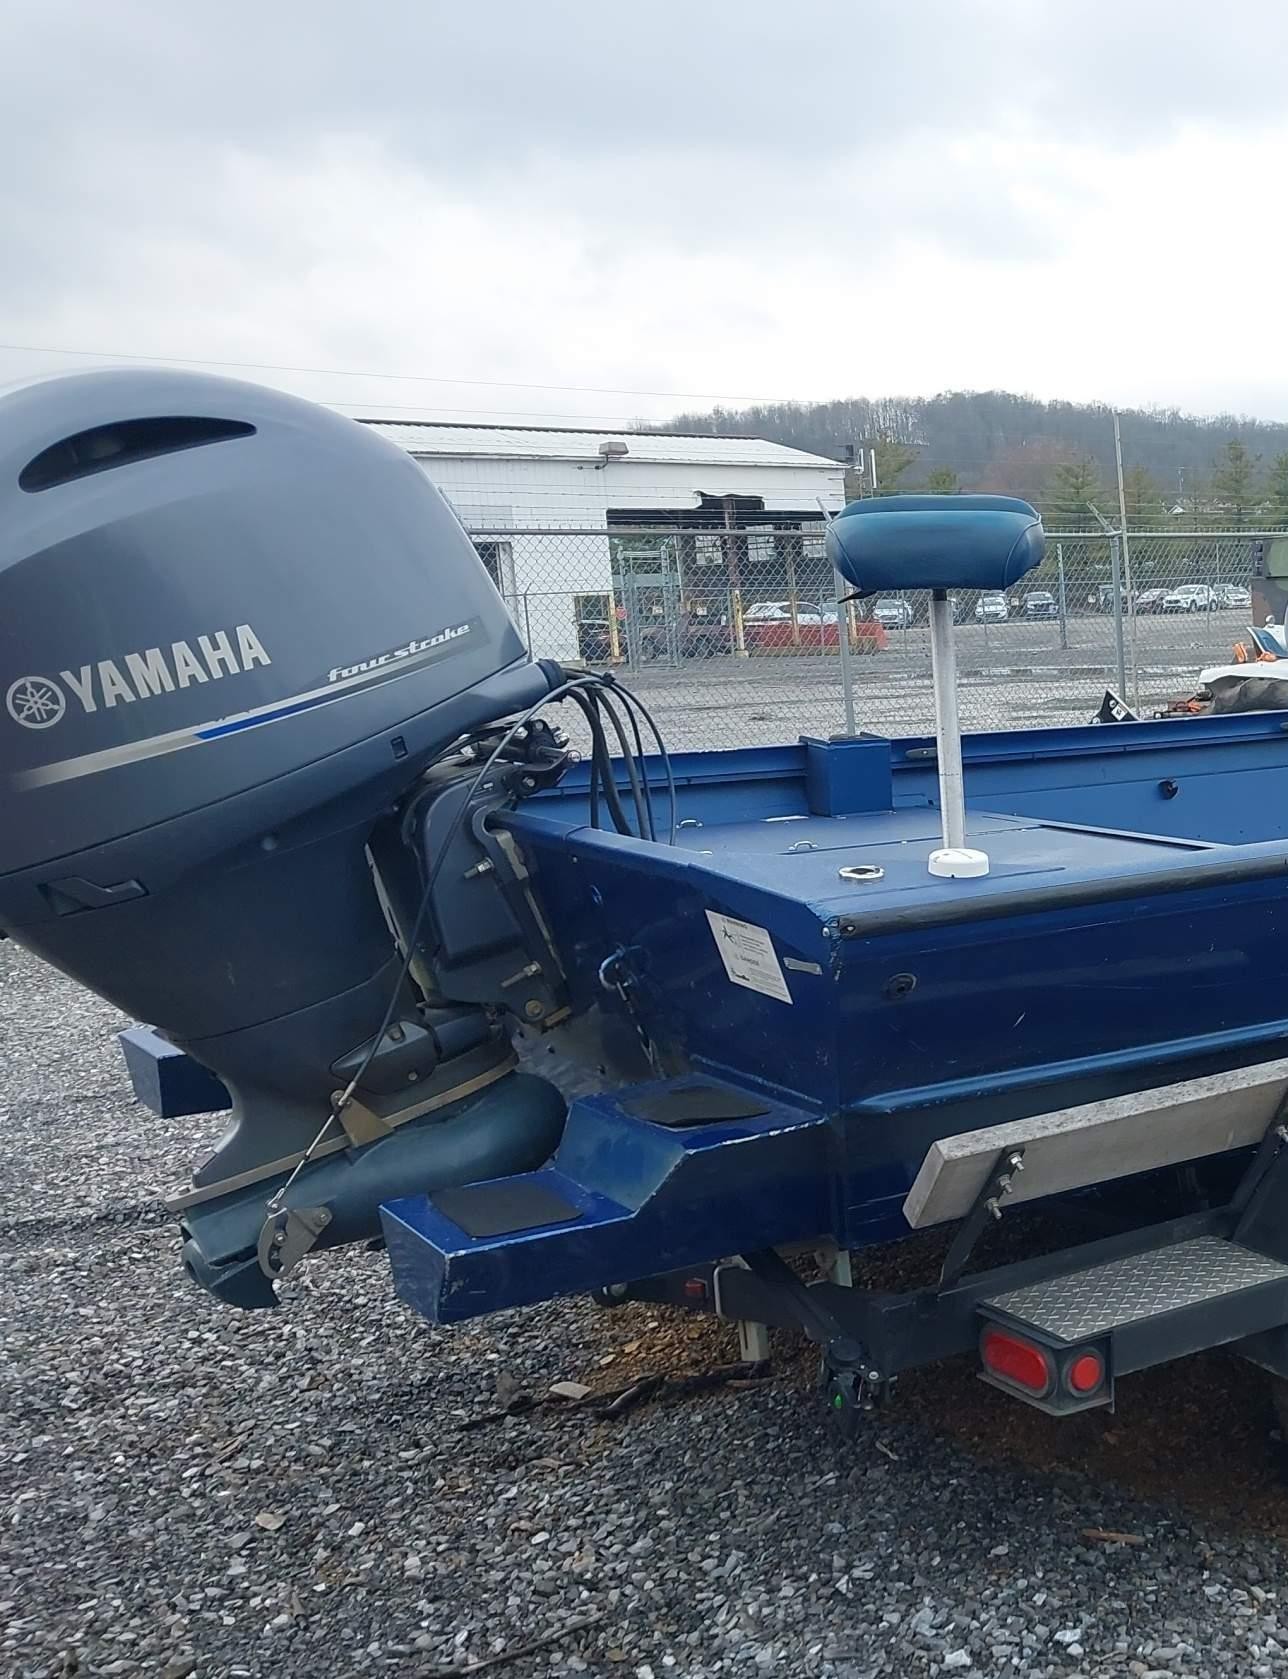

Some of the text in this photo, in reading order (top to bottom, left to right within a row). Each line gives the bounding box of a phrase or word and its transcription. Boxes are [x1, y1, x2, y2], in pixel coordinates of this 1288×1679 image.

[59, 624, 272, 713] YAMAHA
[327, 624, 471, 682] four stroke
